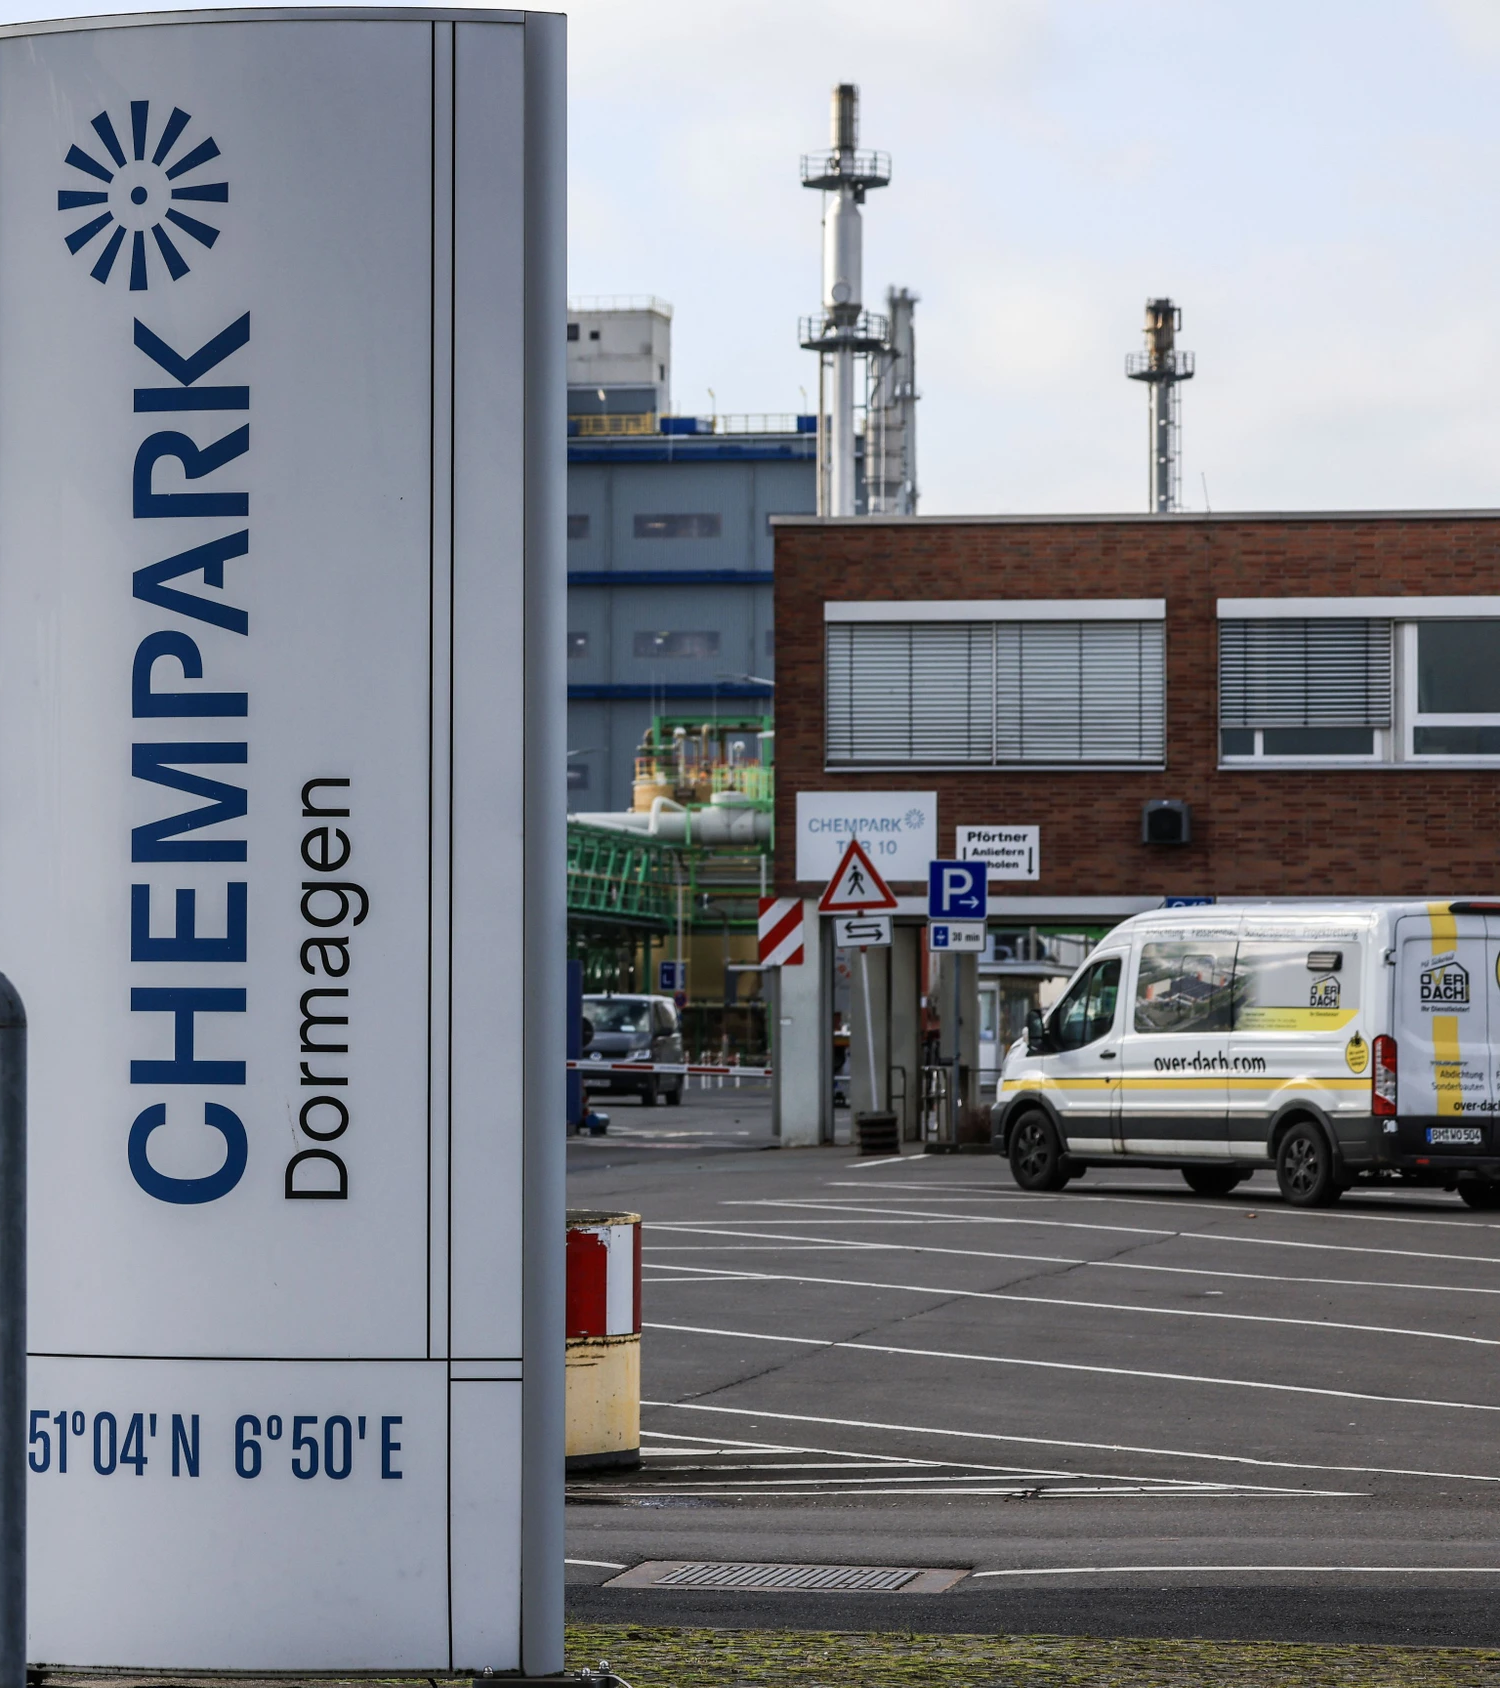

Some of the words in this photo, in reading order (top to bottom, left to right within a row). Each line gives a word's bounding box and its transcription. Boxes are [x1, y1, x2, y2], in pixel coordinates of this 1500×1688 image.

[128, 310, 251, 1205] CHEMPARK
[808, 817, 902, 833] CHEMPARK
[967, 831, 1028, 842] Pförtner
[836, 840, 871, 854] TR
[879, 840, 898, 854] 10
[972, 847, 1025, 856] Anliefern
[987, 860, 1019, 869] holen
[942, 868, 974, 911] P
[1421, 966, 1464, 986] OVER
[284, 777, 370, 1200] Dormagen
[1421, 985, 1465, 1000] DACH
[1154, 1050, 1266, 1072] over-dach.com
